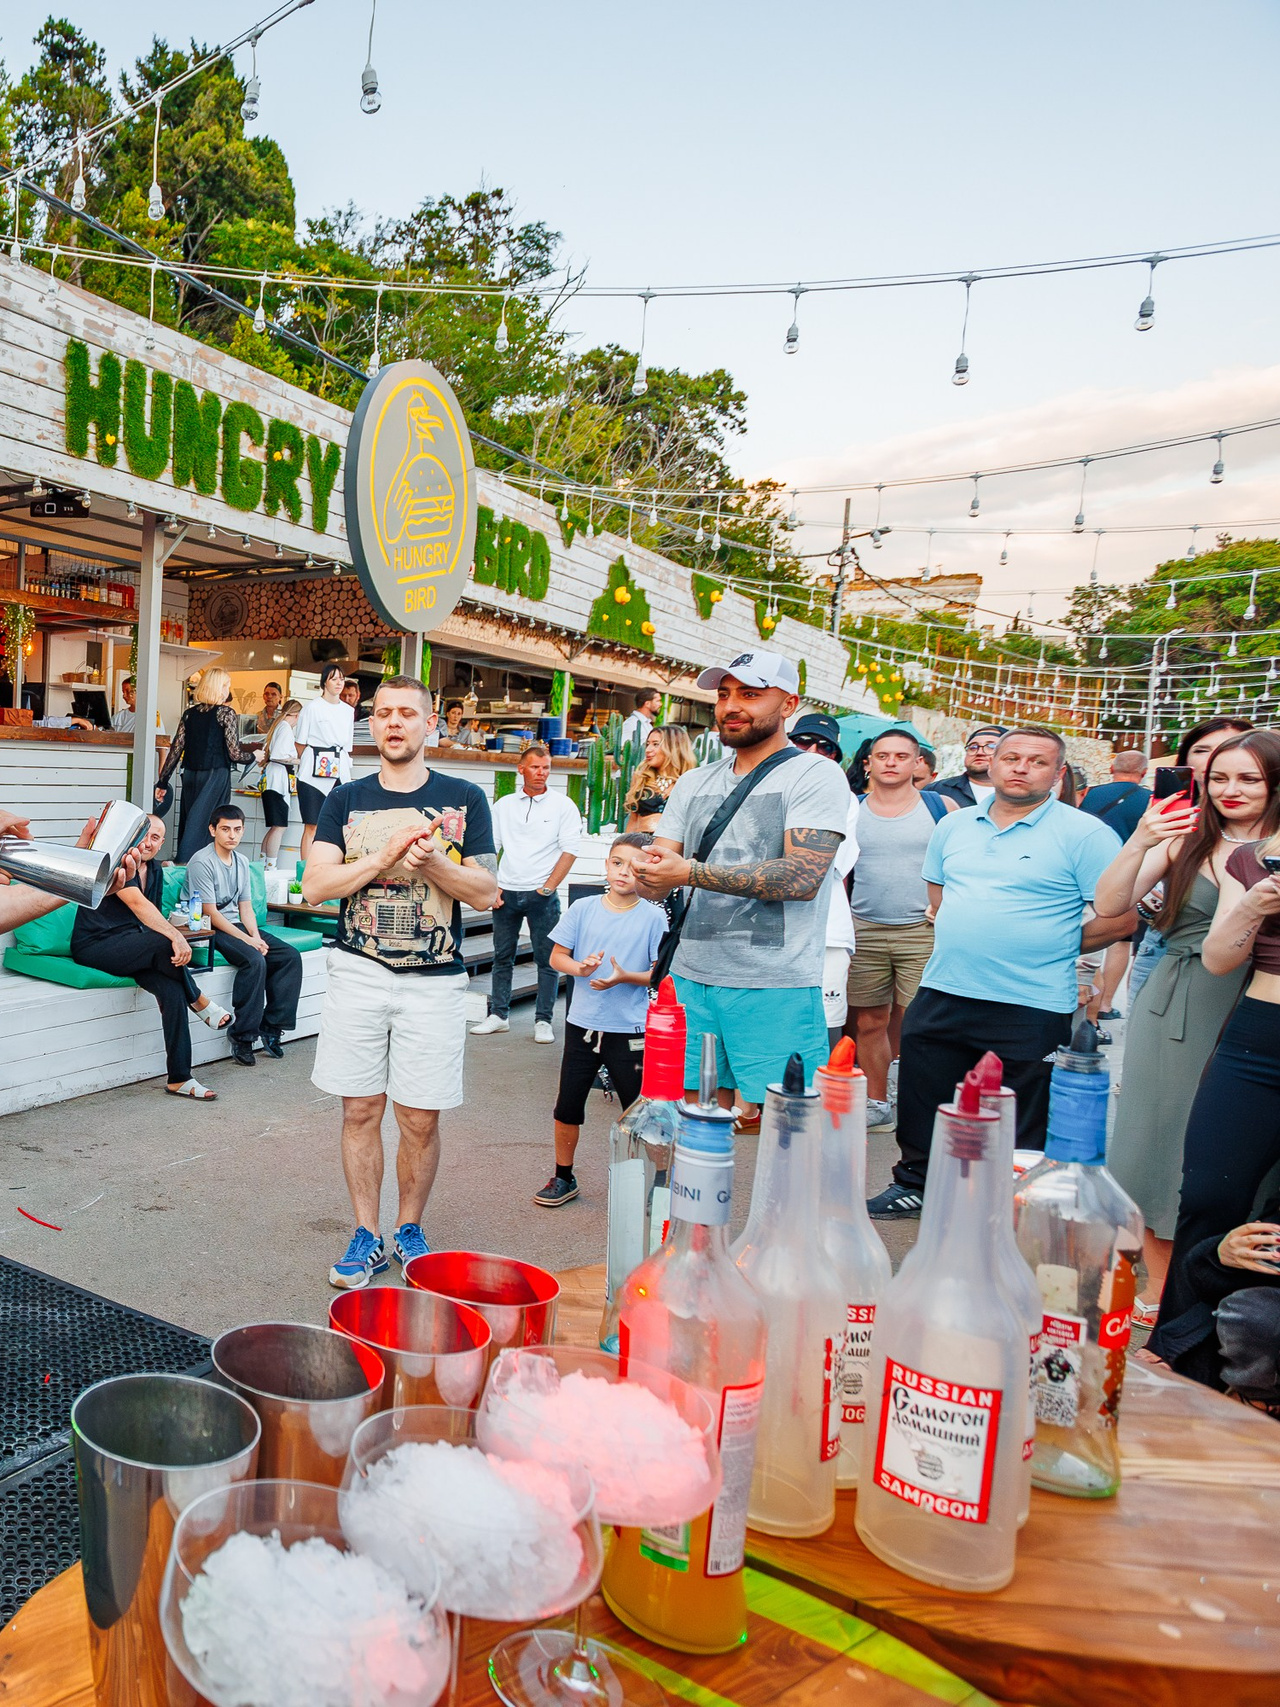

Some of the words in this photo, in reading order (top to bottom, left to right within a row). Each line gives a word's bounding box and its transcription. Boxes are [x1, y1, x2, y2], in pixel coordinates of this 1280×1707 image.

[64, 338, 342, 534] HUNGRY
[473, 505, 551, 601] BIRD
[393, 541, 451, 571] HUNGRY
[404, 585, 437, 613] BIRD
[892, 1364, 993, 1408] RUSSIAN
[893, 1387, 985, 1426] Самогон
[880, 1472, 980, 1521] SAMOGON
